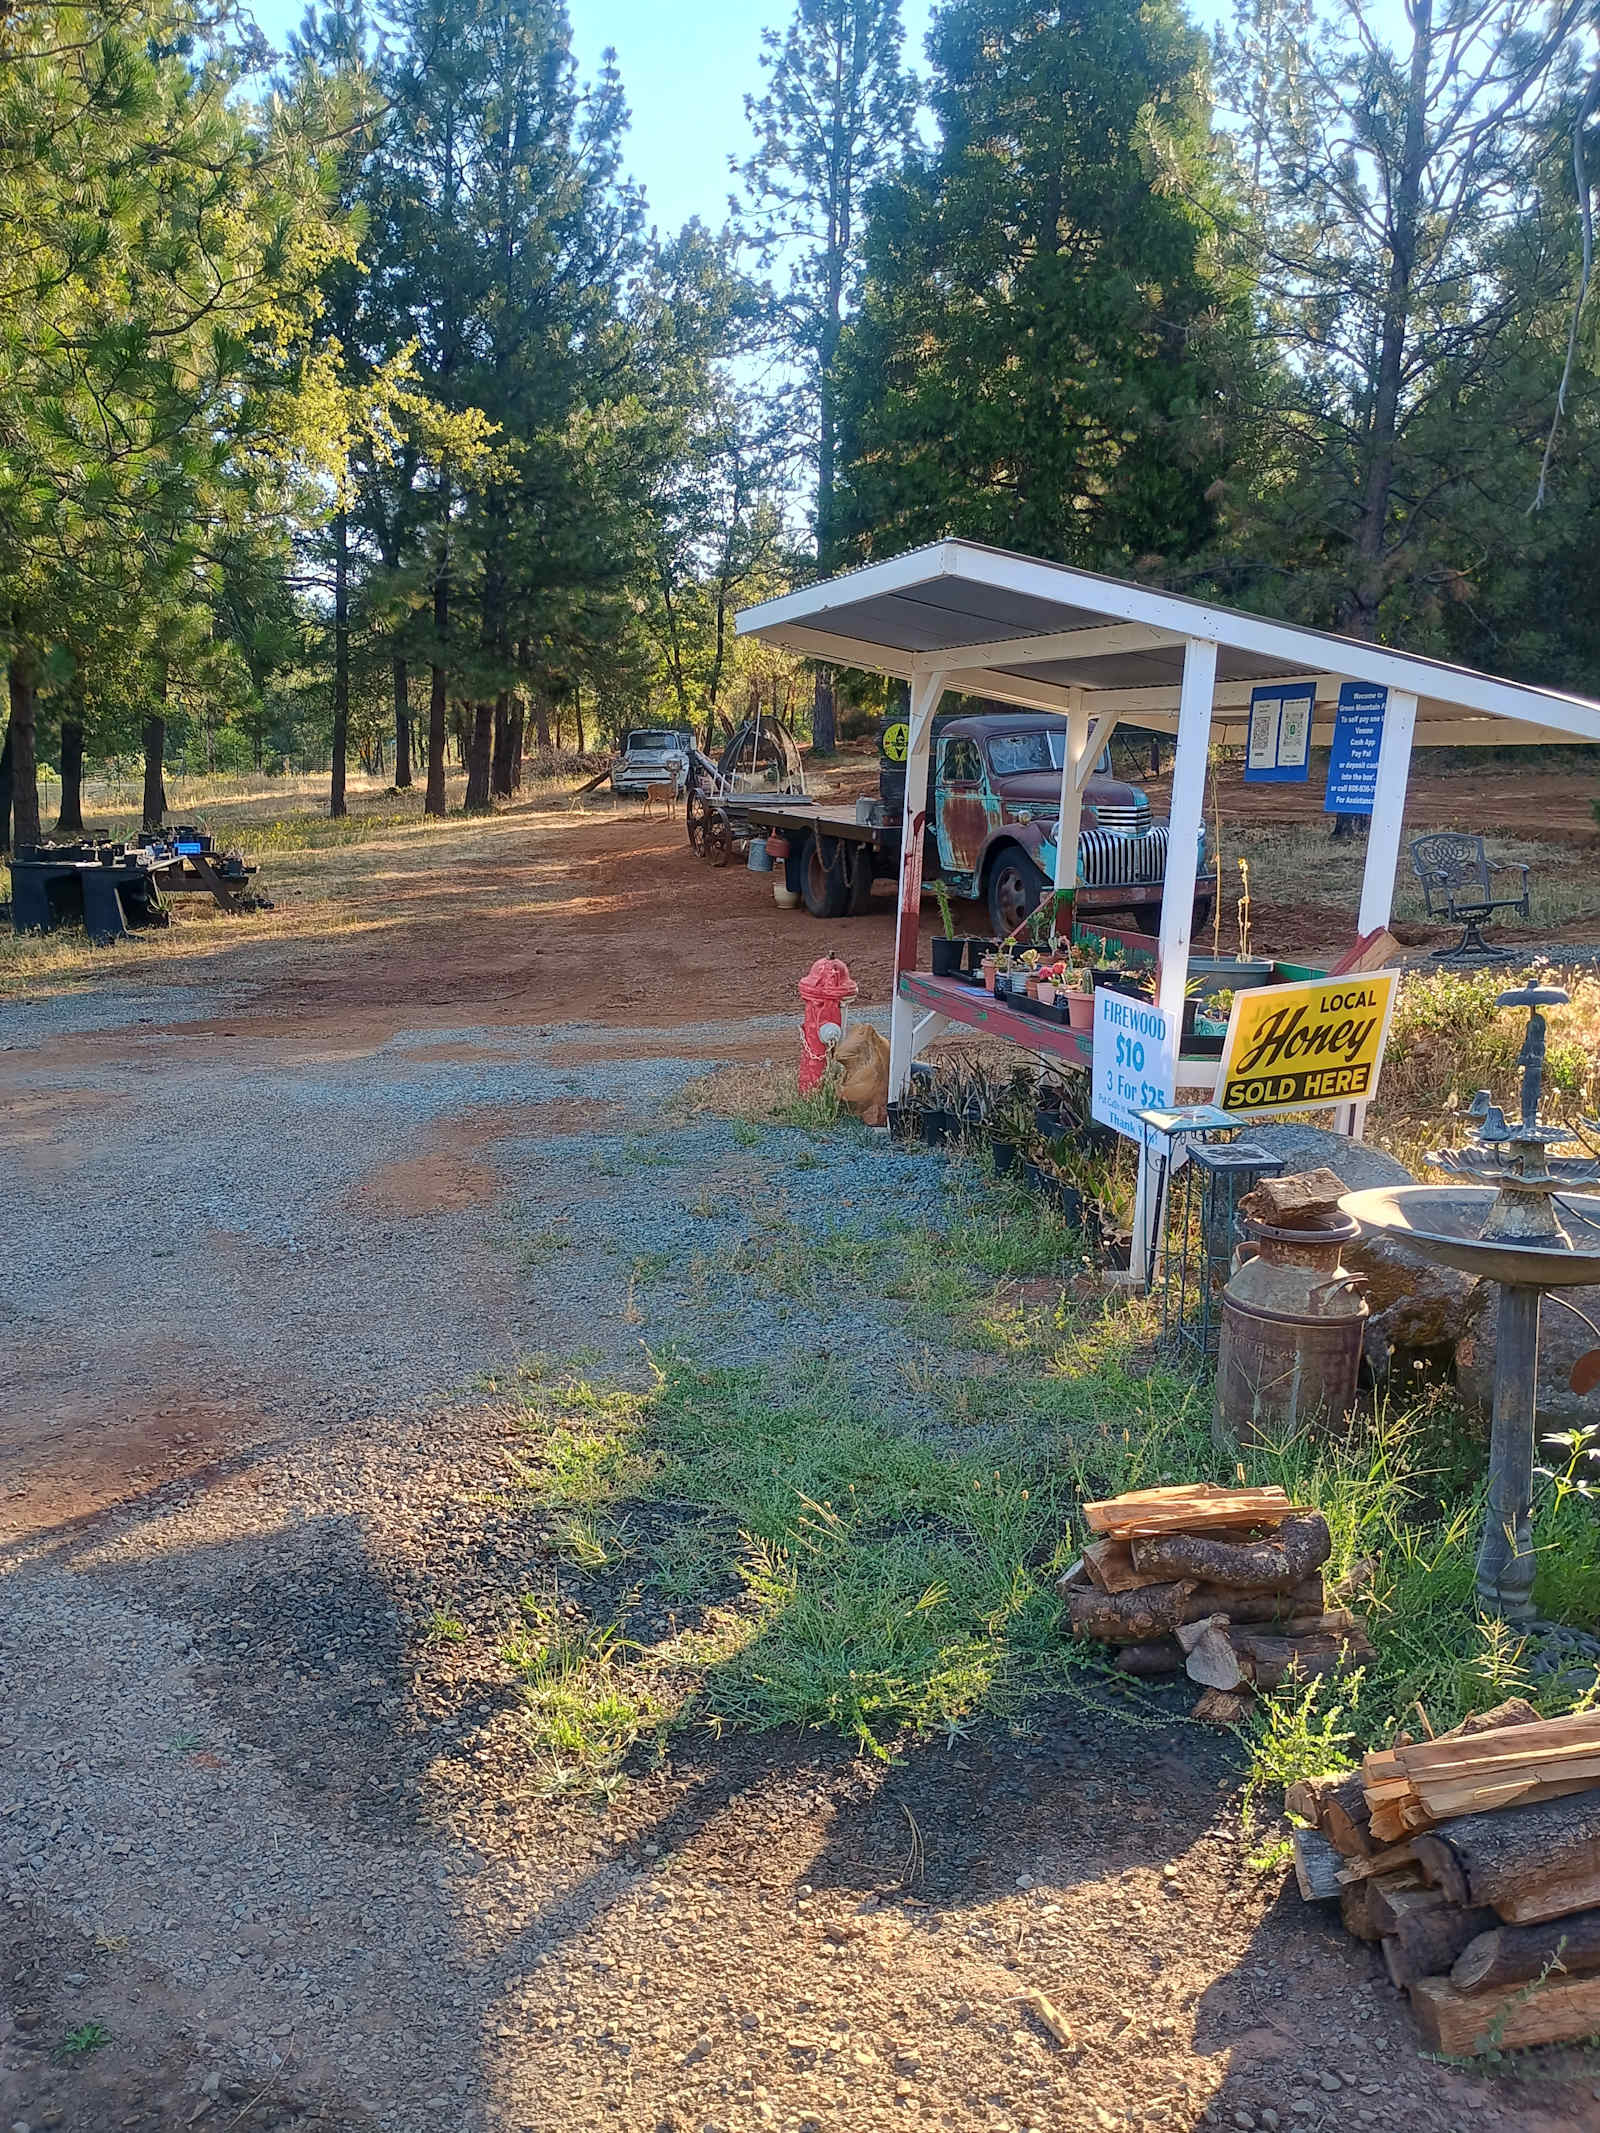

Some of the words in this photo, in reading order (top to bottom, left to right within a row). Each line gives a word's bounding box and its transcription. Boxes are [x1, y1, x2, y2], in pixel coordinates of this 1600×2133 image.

[1341, 715, 1348, 724] To
[1350, 738, 1364, 746] Cash
[1364, 738, 1376, 748] App
[1351, 750, 1362, 758] Pay
[1320, 990, 1377, 1013] LOCAL
[1104, 999, 1166, 1041] FIREWOOD
[1116, 1031, 1145, 1073] $10
[1236, 1005, 1377, 1075] Honey
[1106, 1069, 1113, 1091] 3
[1118, 1074, 1137, 1102] For
[1141, 1080, 1166, 1108] $25
[1228, 1078, 1297, 1107] SOLD
[1304, 1067, 1367, 1097] HERE
[1110, 1111, 1136, 1136] Thank
